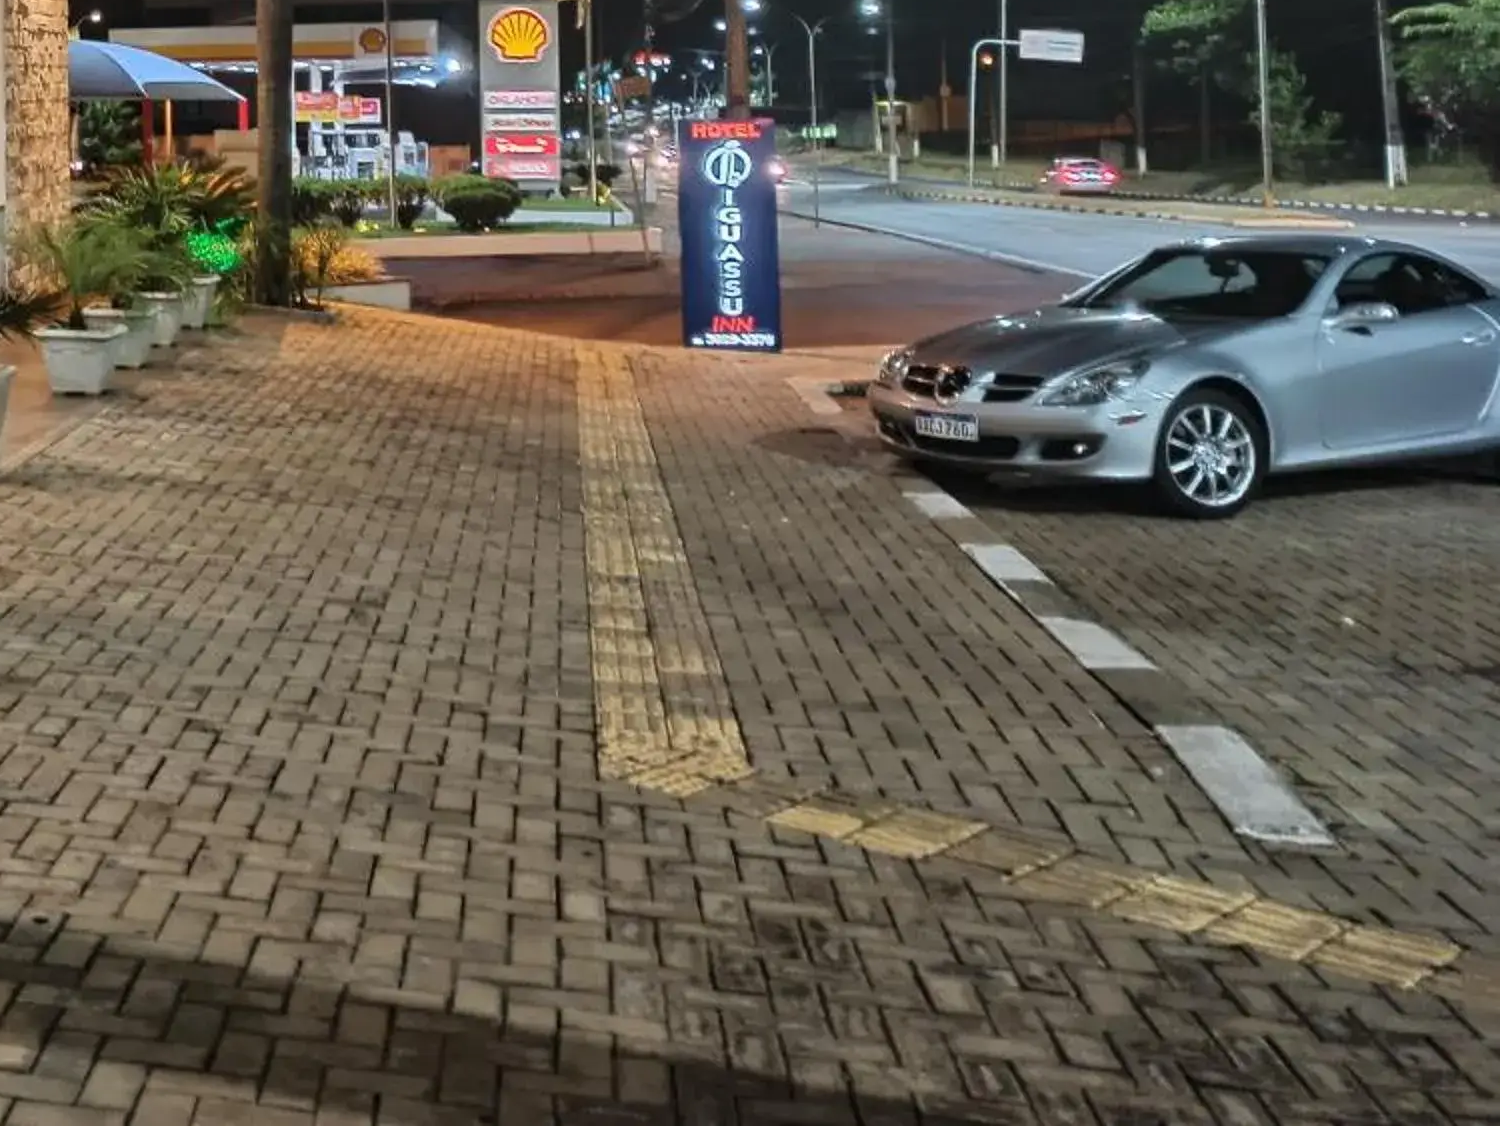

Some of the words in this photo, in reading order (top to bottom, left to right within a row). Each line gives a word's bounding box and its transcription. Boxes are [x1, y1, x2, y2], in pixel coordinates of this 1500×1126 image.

[691, 121, 761, 139] HOTEL
[716, 189, 745, 316] IGUASSU
[711, 316, 755, 333] INN
